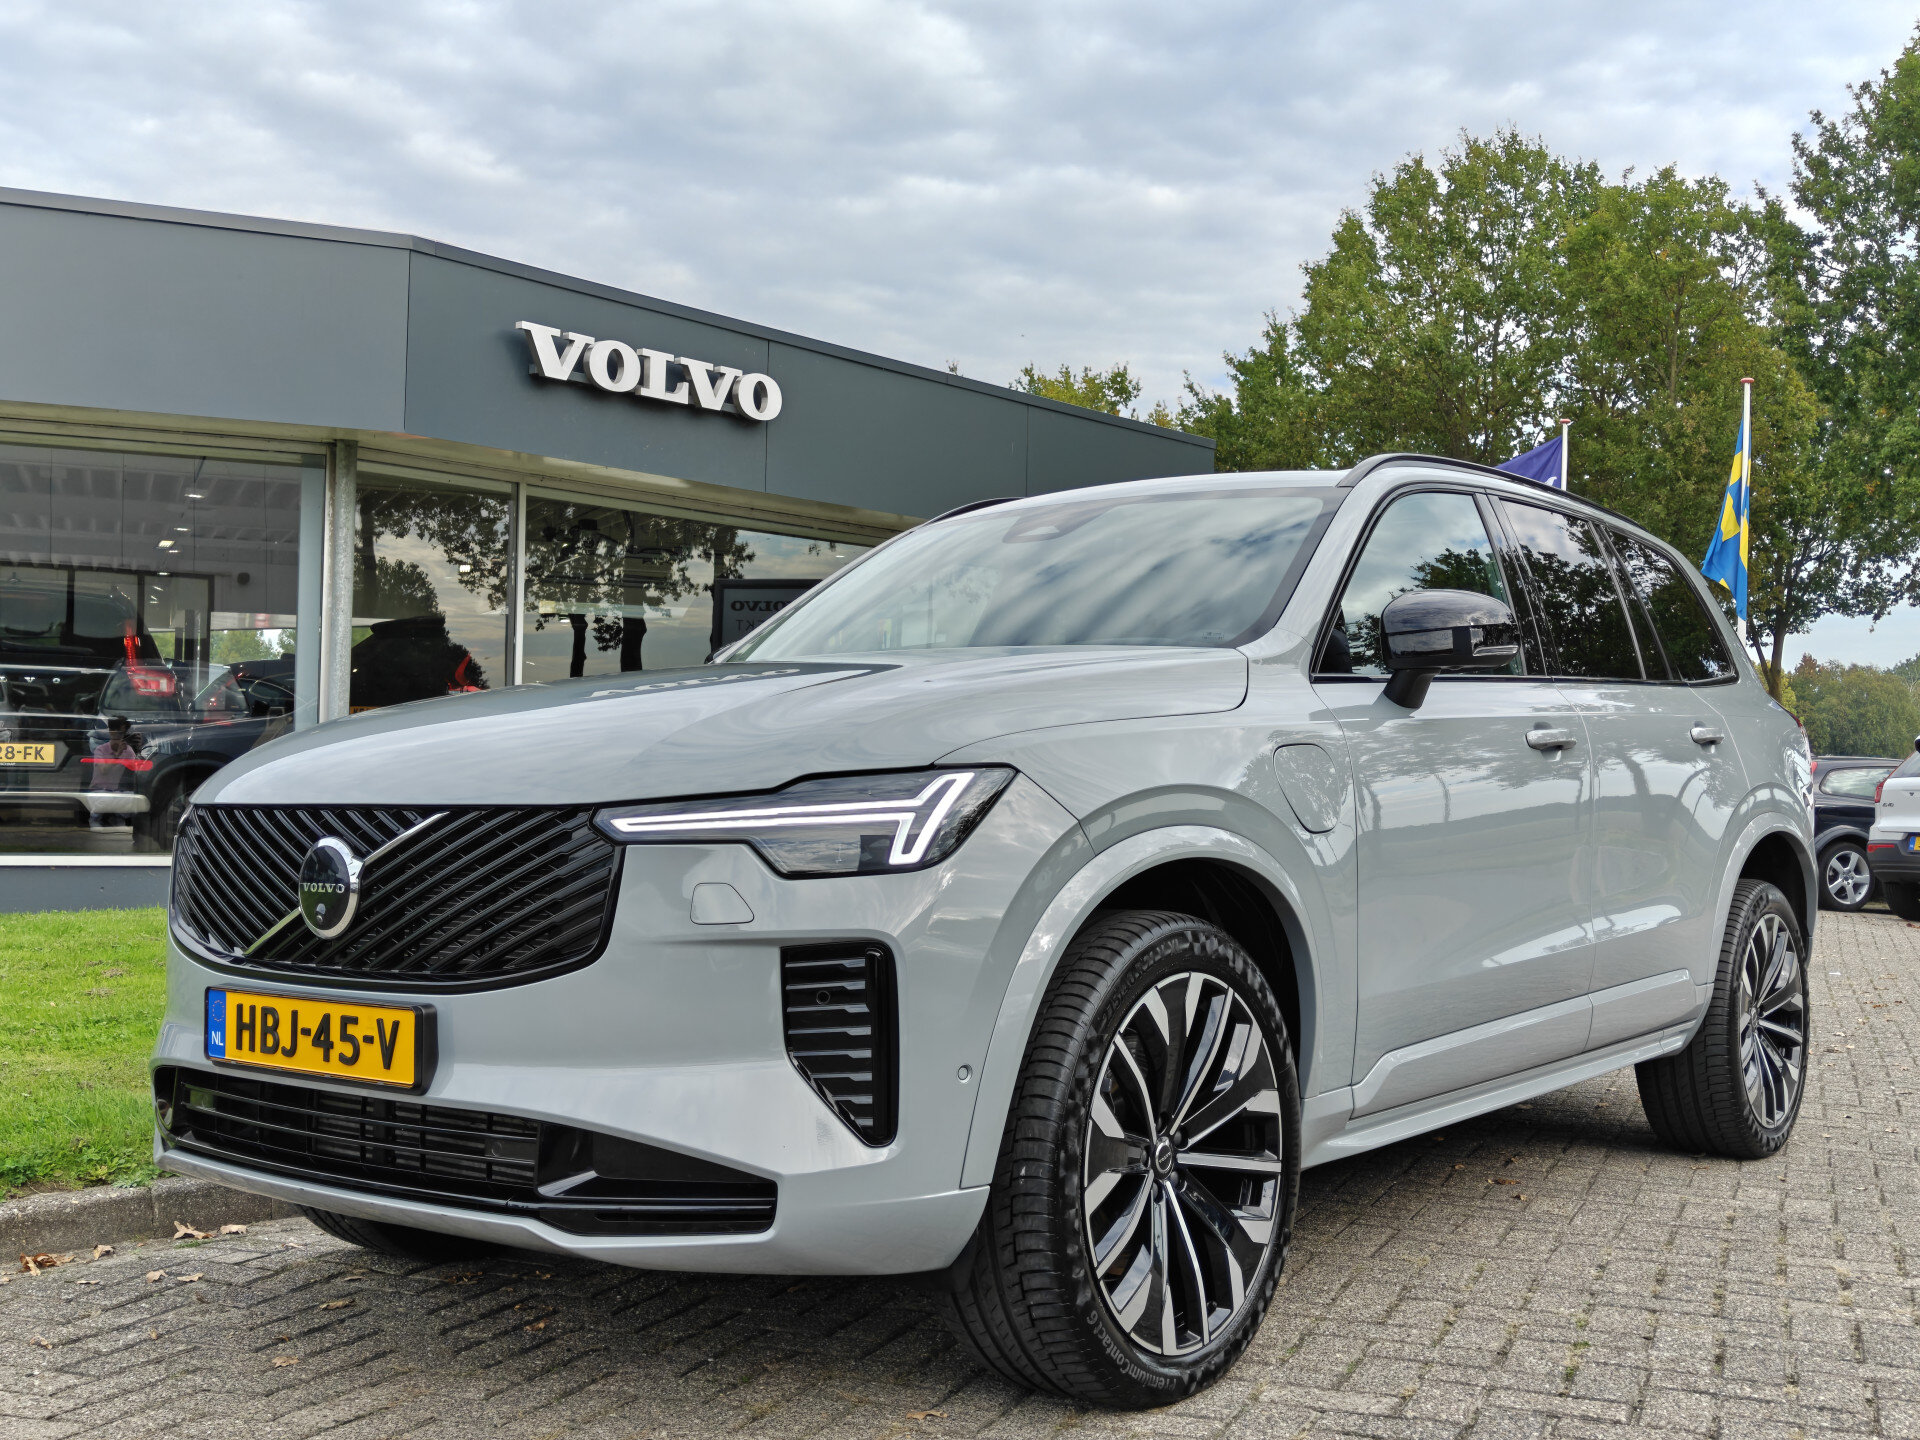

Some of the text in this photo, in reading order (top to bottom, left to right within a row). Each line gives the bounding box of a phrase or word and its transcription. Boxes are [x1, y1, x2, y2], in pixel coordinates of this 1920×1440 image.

[516, 320, 783, 421] VOLVO
[0, 745, 45, 761] 8-FK
[303, 882, 345, 894] VOLVO
[211, 1031, 224, 1046] NL
[236, 1003, 400, 1070] HBJ-45-V
